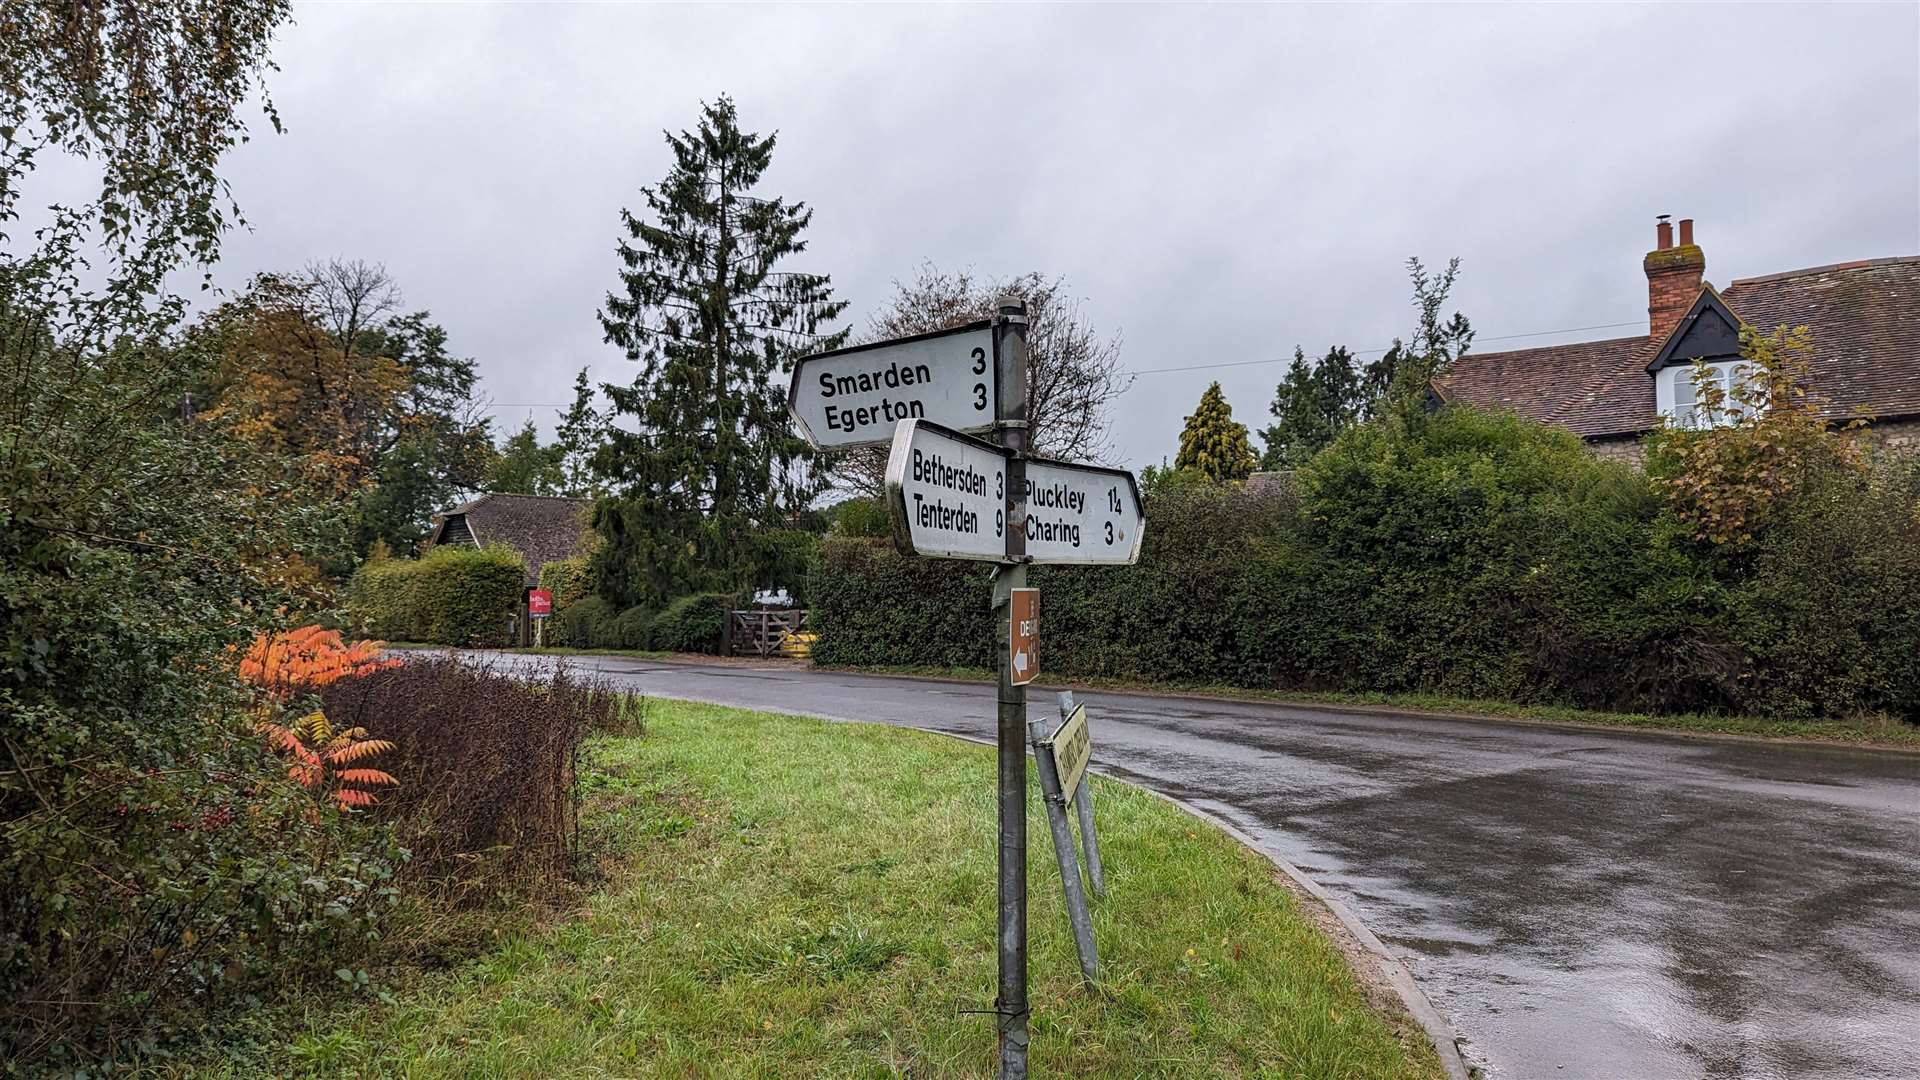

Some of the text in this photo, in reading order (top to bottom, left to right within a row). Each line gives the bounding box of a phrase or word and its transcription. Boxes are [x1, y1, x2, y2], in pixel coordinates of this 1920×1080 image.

[819, 347, 986, 398] Smarden 3
[824, 383, 987, 432] Egerton 3
[913, 448, 1004, 500] Bethersden 3
[913, 493, 1003, 538] Tenterden 9
[1026, 513, 1114, 548] Charing 3
